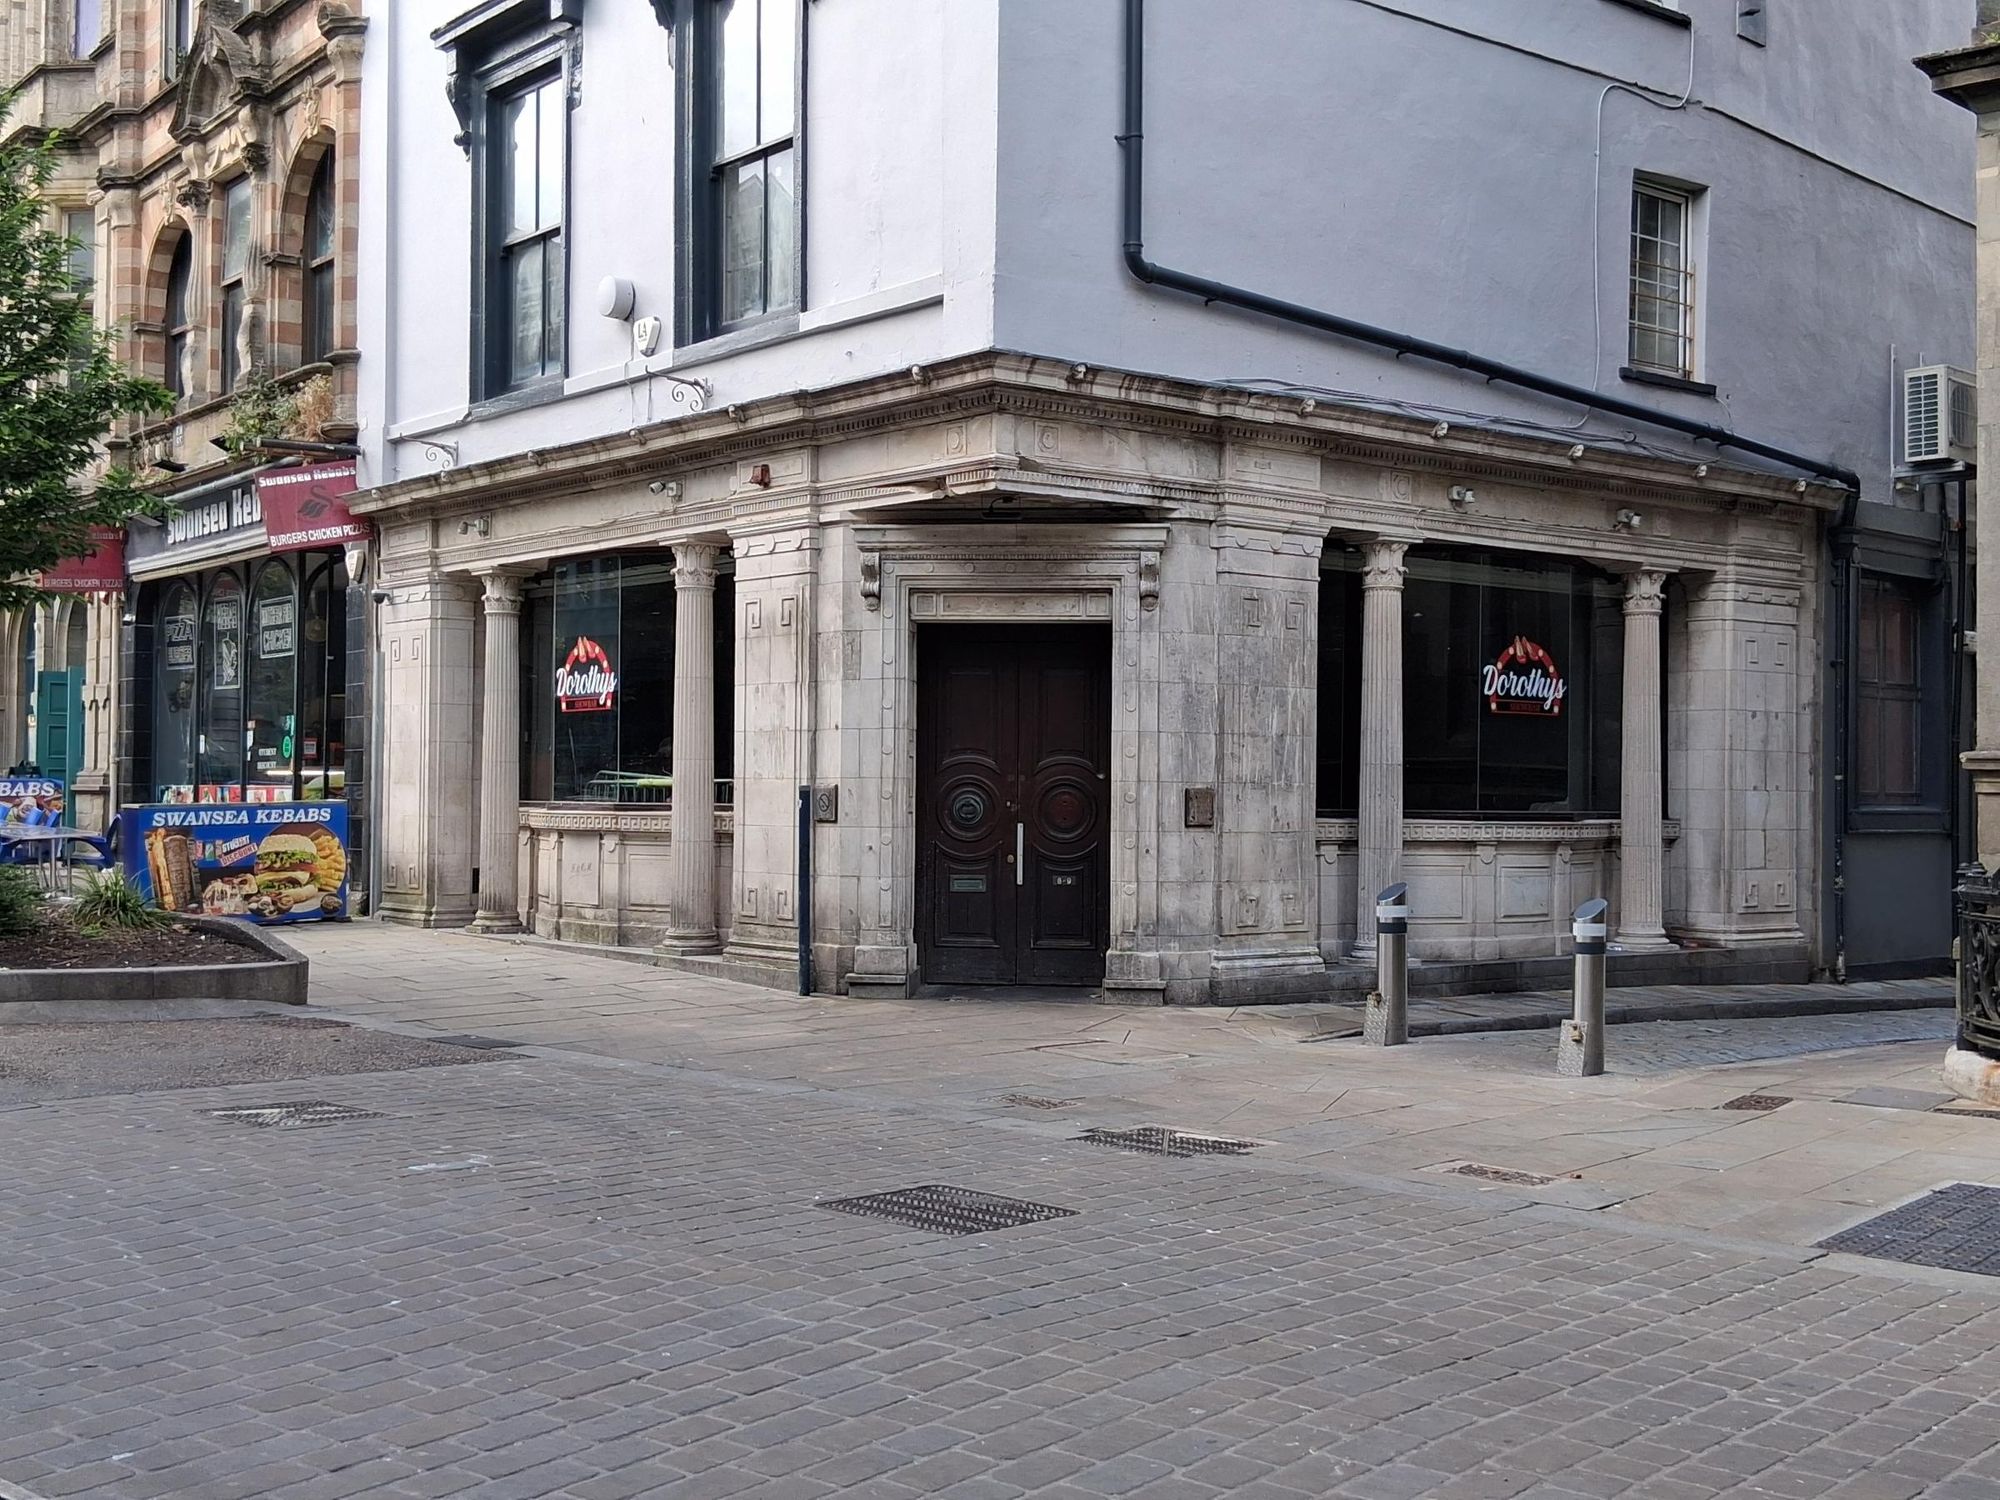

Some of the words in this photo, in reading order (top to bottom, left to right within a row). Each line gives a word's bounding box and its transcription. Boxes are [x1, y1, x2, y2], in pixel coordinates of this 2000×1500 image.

[259, 473, 312, 488] Swansea
[314, 466, 357, 480] Kebabs
[167, 501, 228, 545] Swansea
[232, 484, 262, 528] Keb
[269, 530, 308, 547] BURGERS
[308, 525, 342, 541] CHICKEN
[343, 521, 371, 536] PIZZAS
[44, 578, 73, 588] BURGERS
[74, 578, 101, 588] CHICKEN
[102, 578, 123, 588] PIZZAS
[556, 665, 618, 706] Dorothys
[1482, 664, 1567, 710] Dorothys
[152, 809, 249, 827] SWANSEA
[254, 807, 331, 824] KEBABS
